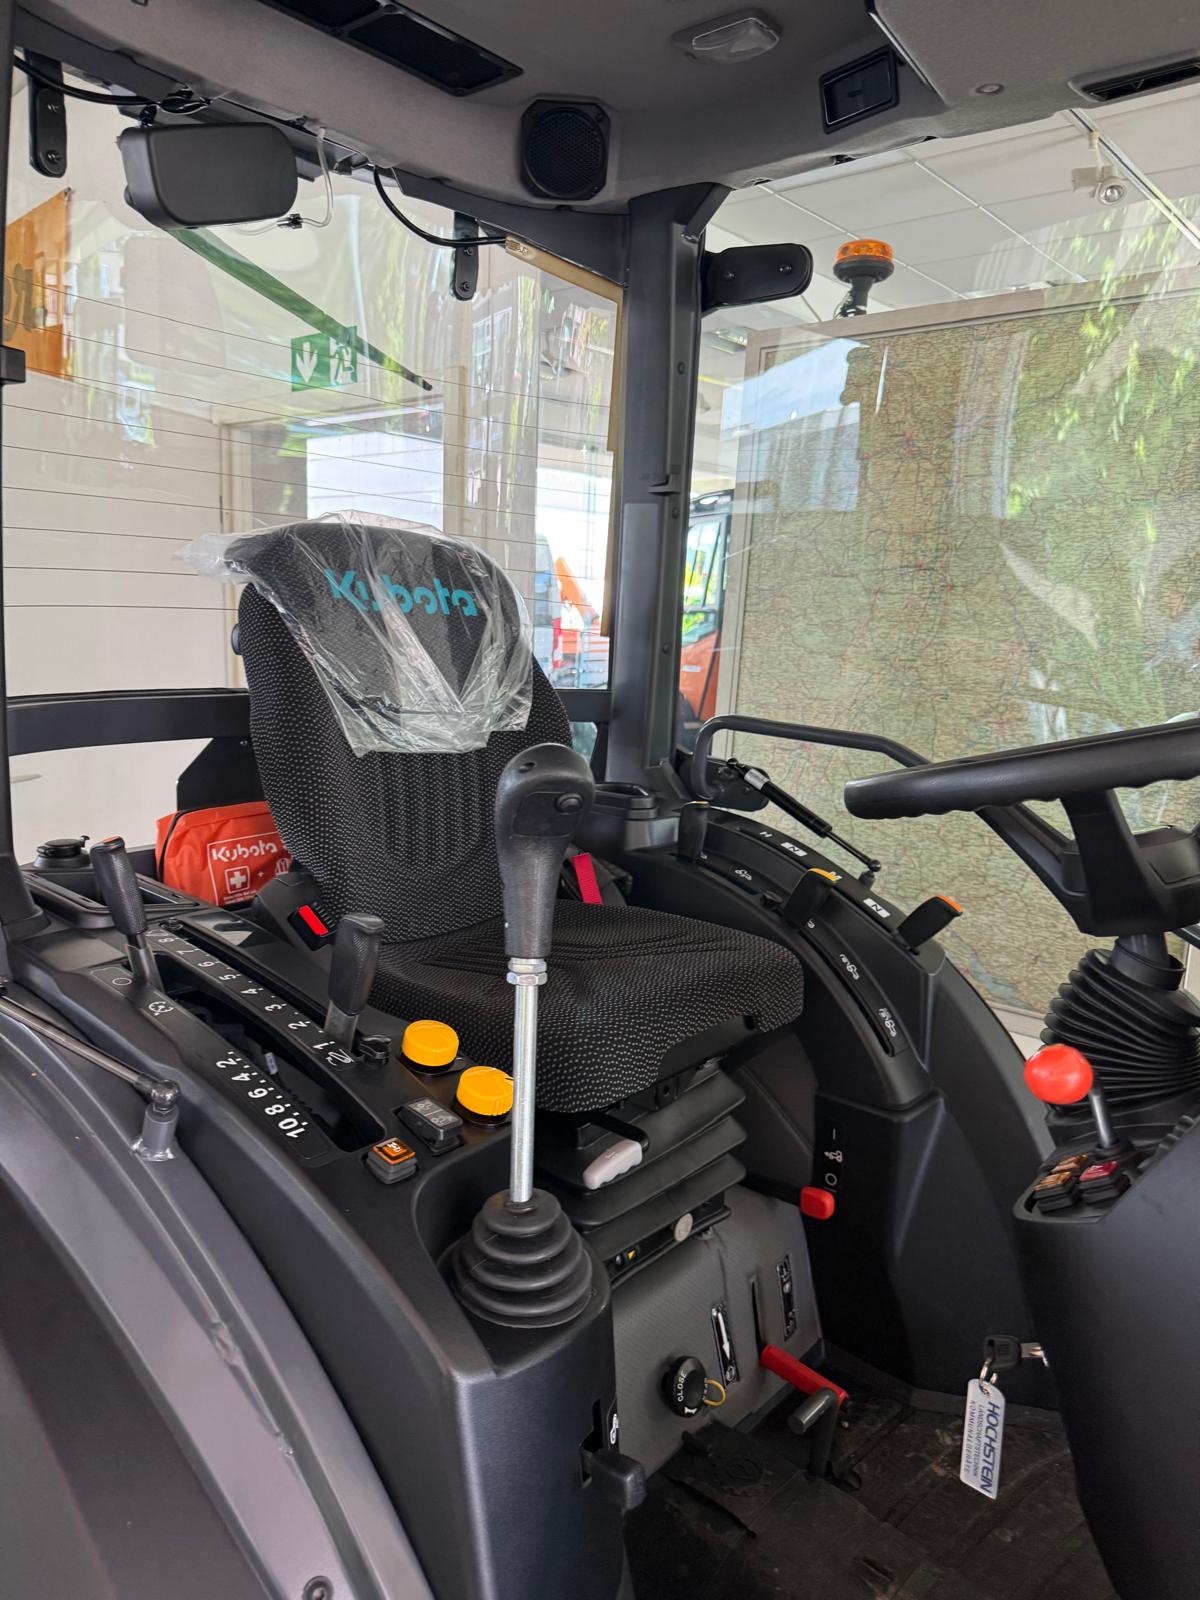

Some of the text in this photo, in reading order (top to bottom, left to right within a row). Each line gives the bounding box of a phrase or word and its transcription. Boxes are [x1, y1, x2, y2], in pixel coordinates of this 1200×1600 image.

[211, 840, 278, 862] Kubota
[264, 1004, 282, 1012] 3
[287, 1021, 308, 1030] 2
[313, 1042, 329, 1050] 1
[215, 1058, 305, 1138] 2 4 6 8 10
[677, 1370, 688, 1402] CLOSE
[980, 1401, 1001, 1493] HOCHSTEIN
